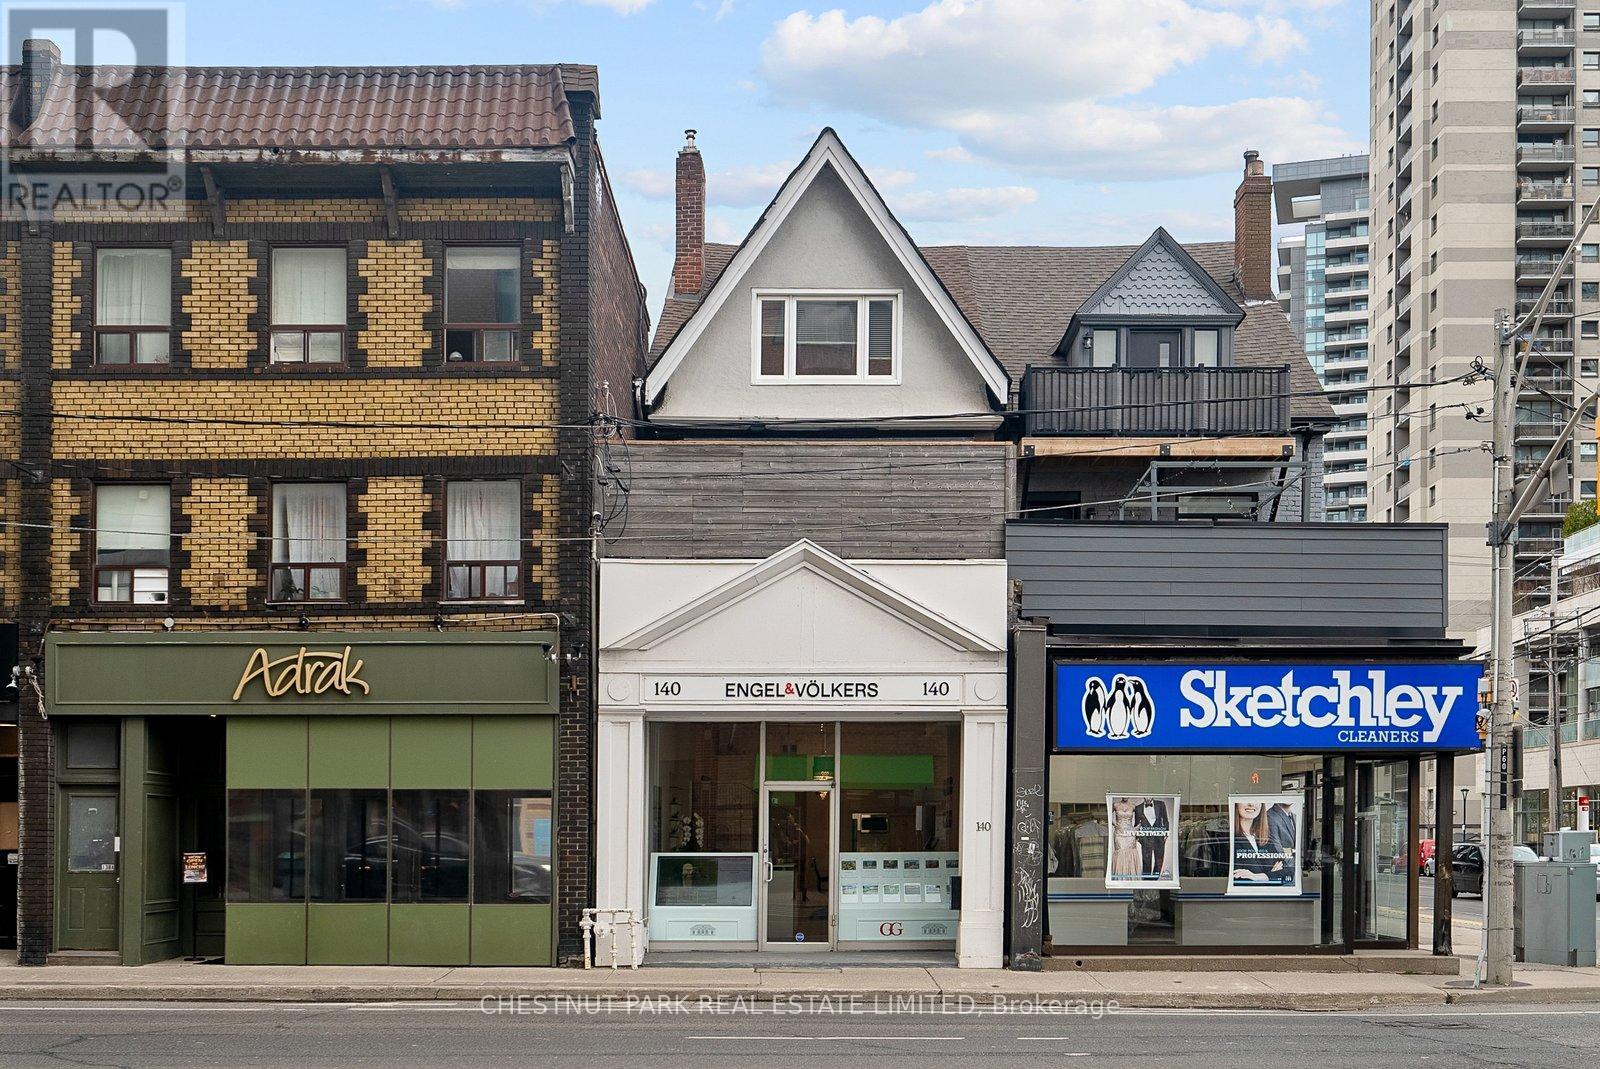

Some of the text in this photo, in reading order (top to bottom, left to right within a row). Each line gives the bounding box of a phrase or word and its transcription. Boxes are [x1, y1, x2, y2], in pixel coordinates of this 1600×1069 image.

[232, 645, 370, 700] Adrak
[654, 681, 681, 697] 140
[725, 680, 879, 698] ENGEL&VÖLKERS
[922, 681, 949, 697] 140
[1179, 669, 1464, 743] Sketchley
[1337, 730, 1419, 743] CLEANERS
[975, 821, 991, 831] 140
